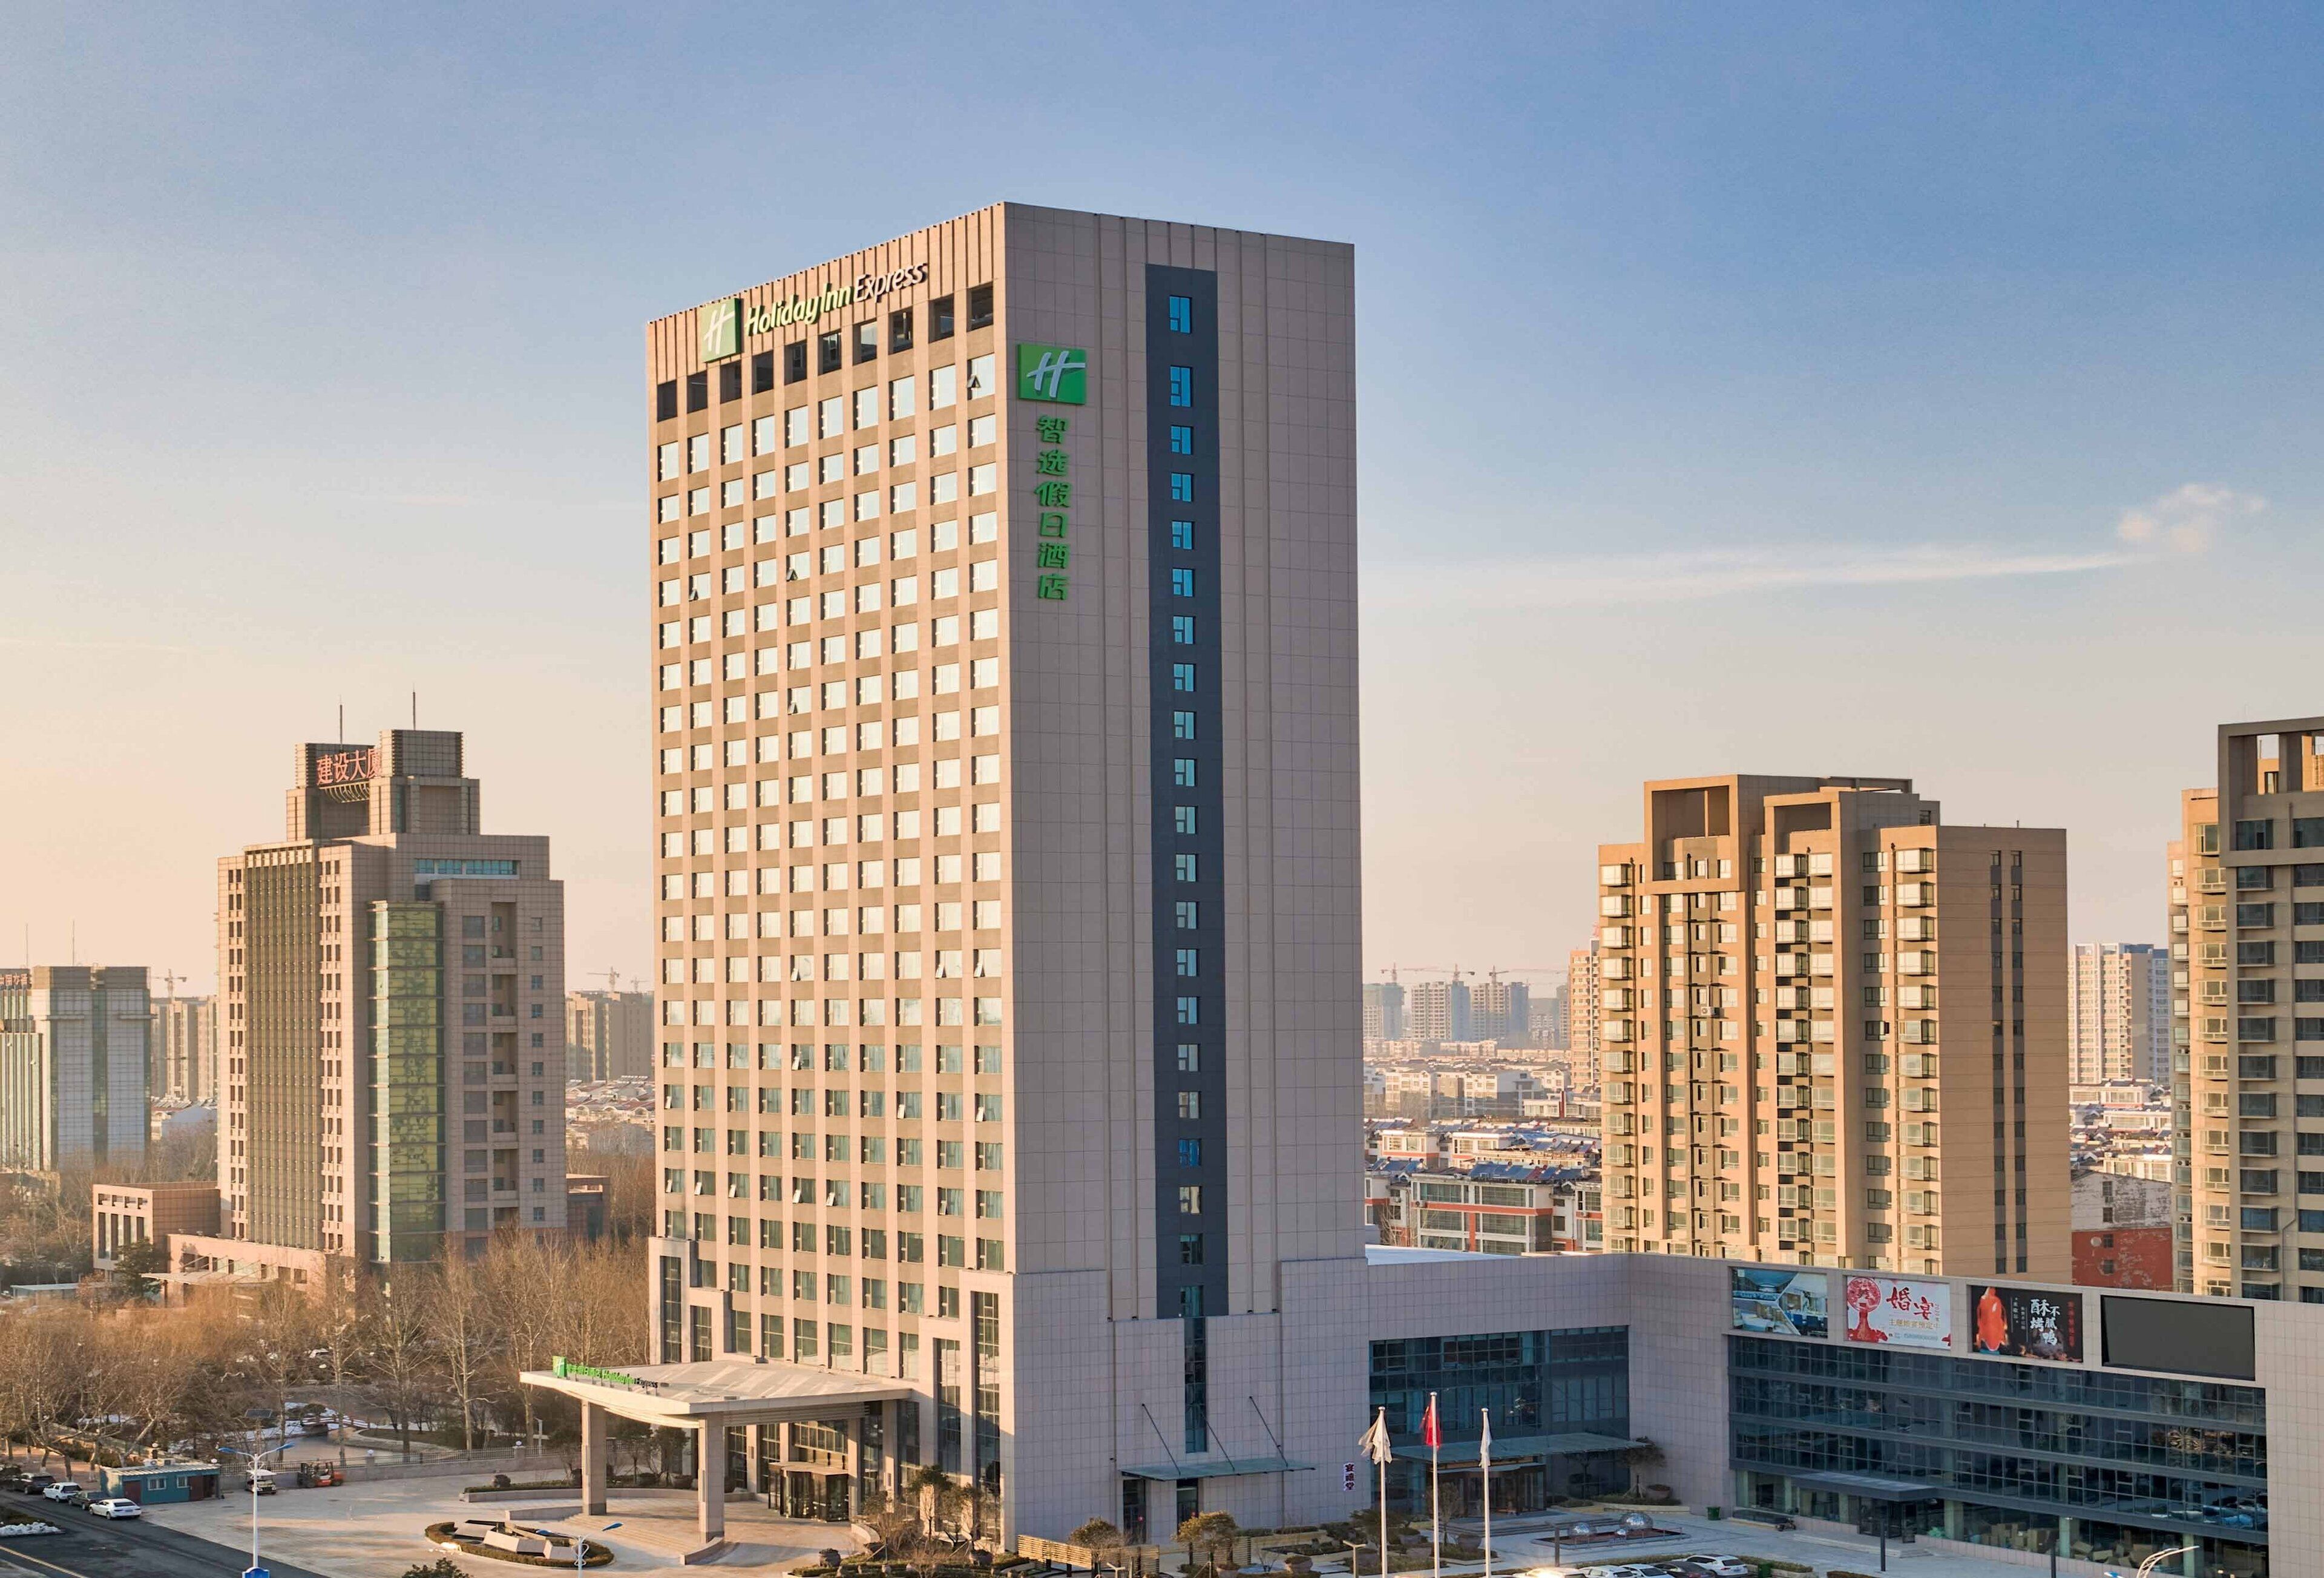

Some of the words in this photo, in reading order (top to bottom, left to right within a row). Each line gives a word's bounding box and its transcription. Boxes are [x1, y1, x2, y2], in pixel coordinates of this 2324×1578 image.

[744, 295, 819, 336] Holiday
[820, 283, 854, 312] Inn
[854, 263, 928, 303] Express
[1034, 415, 1071, 601] 智选假日酒店
[1886, 1286, 1934, 1320] 婚宴
